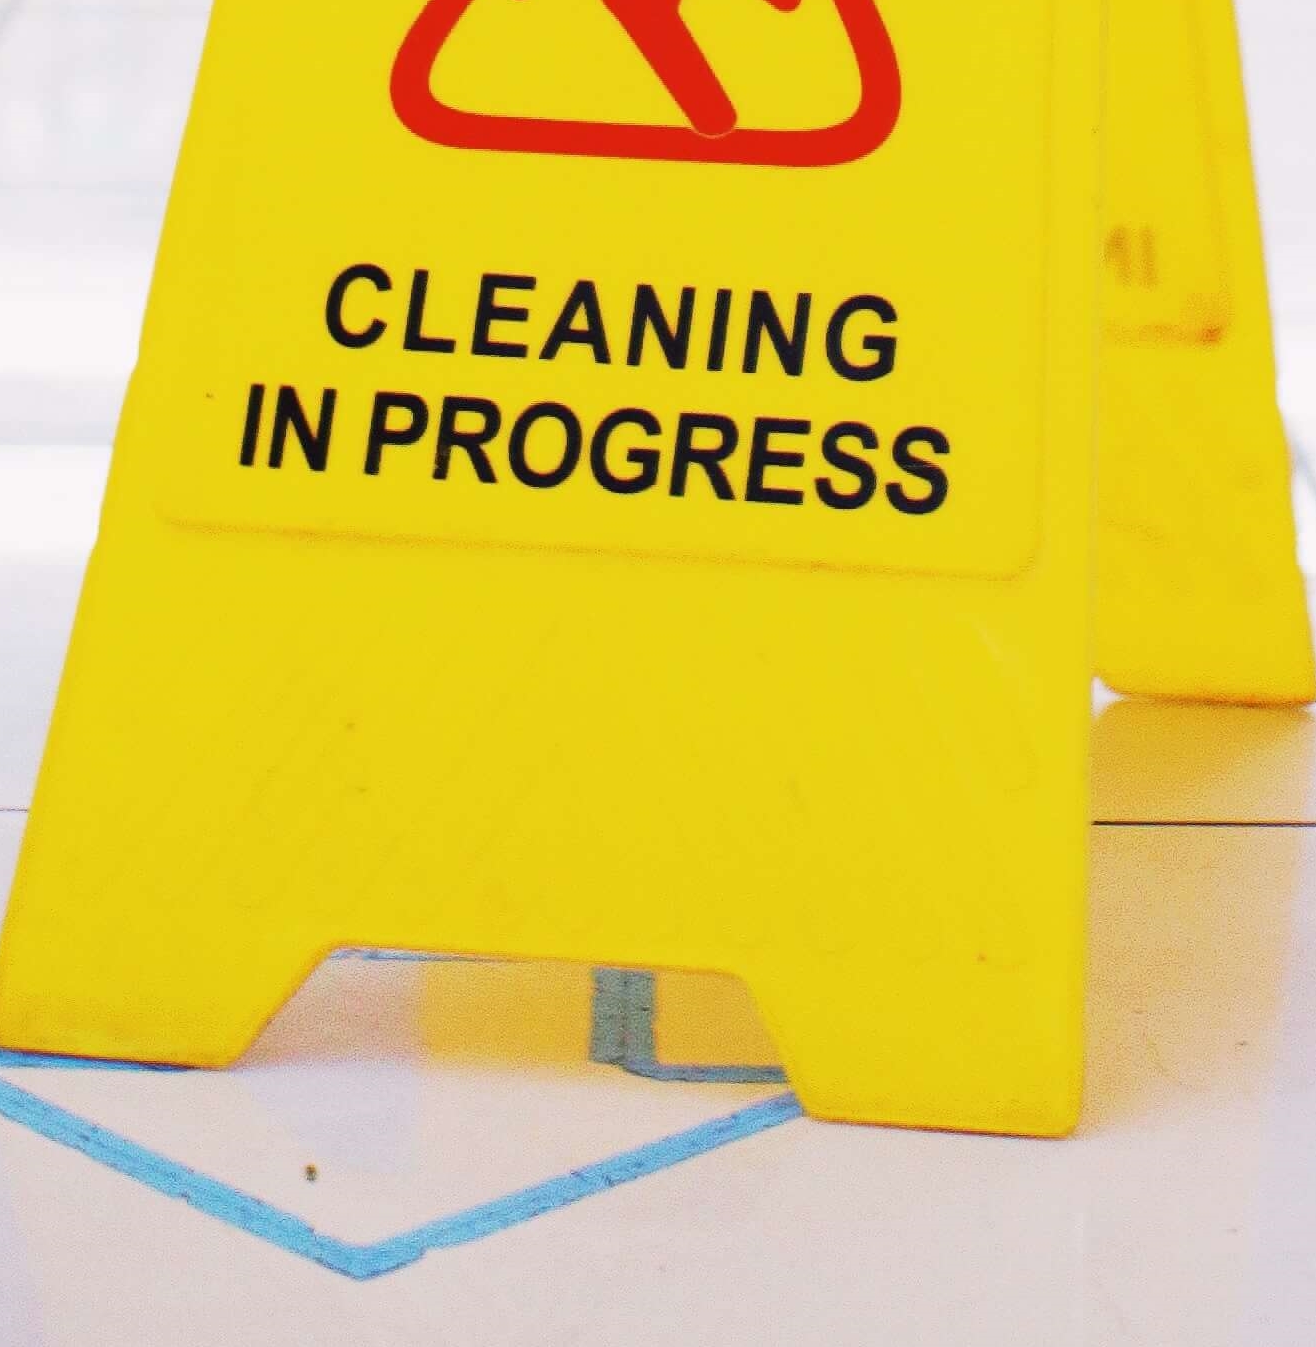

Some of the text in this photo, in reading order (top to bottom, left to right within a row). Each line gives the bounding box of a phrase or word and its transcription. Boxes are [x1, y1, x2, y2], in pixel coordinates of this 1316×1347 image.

[325, 264, 898, 382] CLEANING
[239, 384, 950, 515] IN PROGRESS
